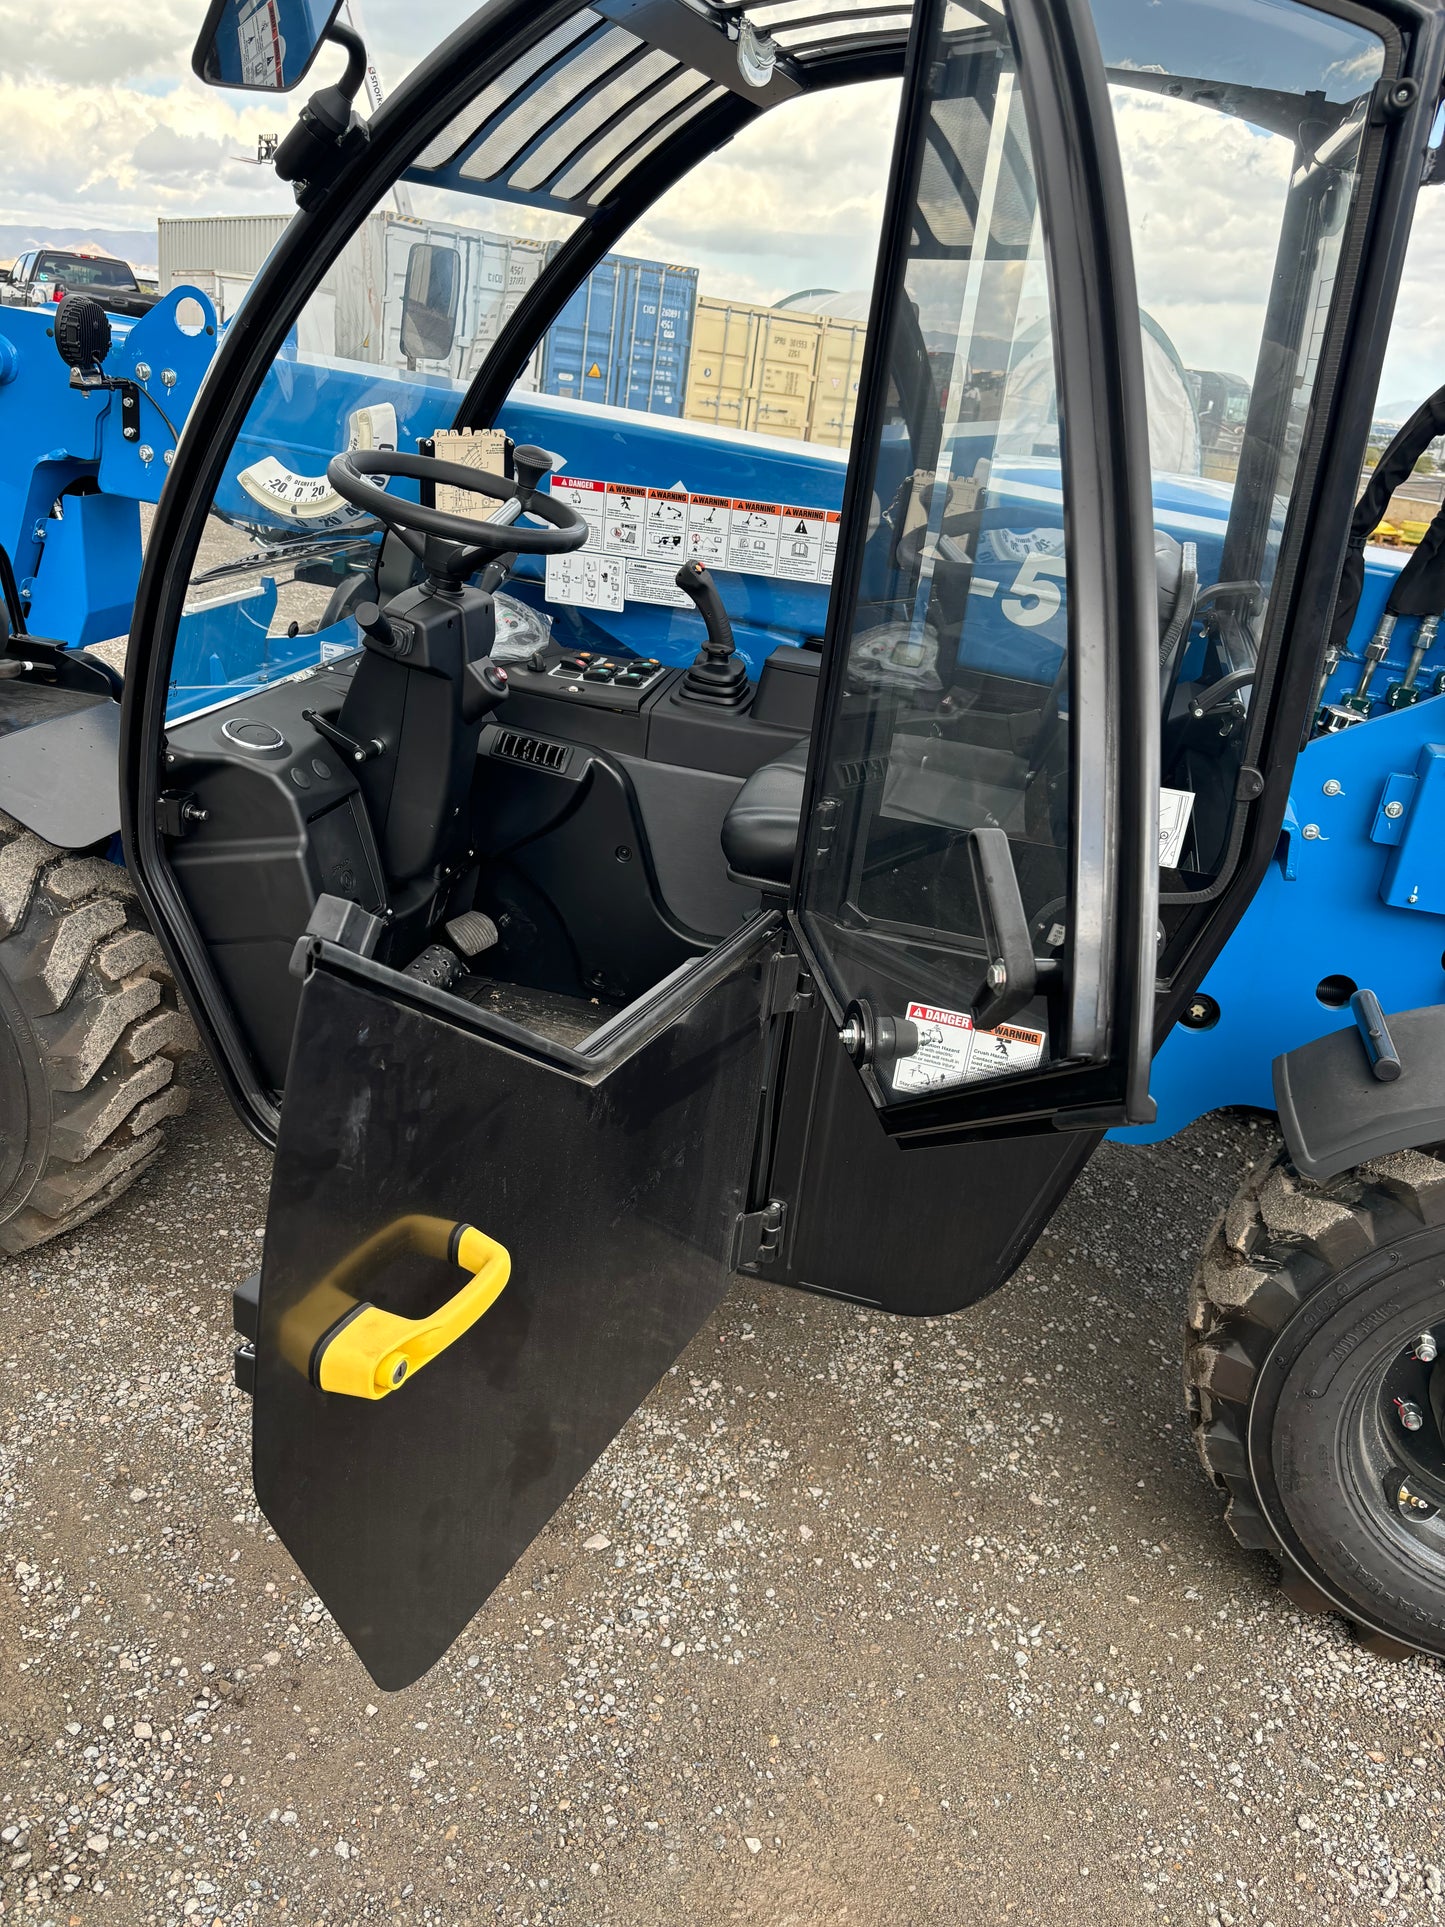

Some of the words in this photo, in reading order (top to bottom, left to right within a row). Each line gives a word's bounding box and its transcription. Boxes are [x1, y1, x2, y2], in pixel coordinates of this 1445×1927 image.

[268, 478, 288, 493] -20
[294, 486, 304, 498] 0
[311, 485, 325, 498] 20
[569, 479, 594, 490] DANGER
[615, 485, 646, 497] WARNING
[656, 490, 687, 502] WARNING
[698, 496, 729, 507] WARNING
[745, 502, 776, 513] WARNING
[792, 508, 824, 519] WARNING
[318, 516, 343, 528] 20
[925, 1009, 971, 1030] DANGER
[994, 1026, 1038, 1043] WARNING
[1355, 1301, 1400, 1334] SERIES
